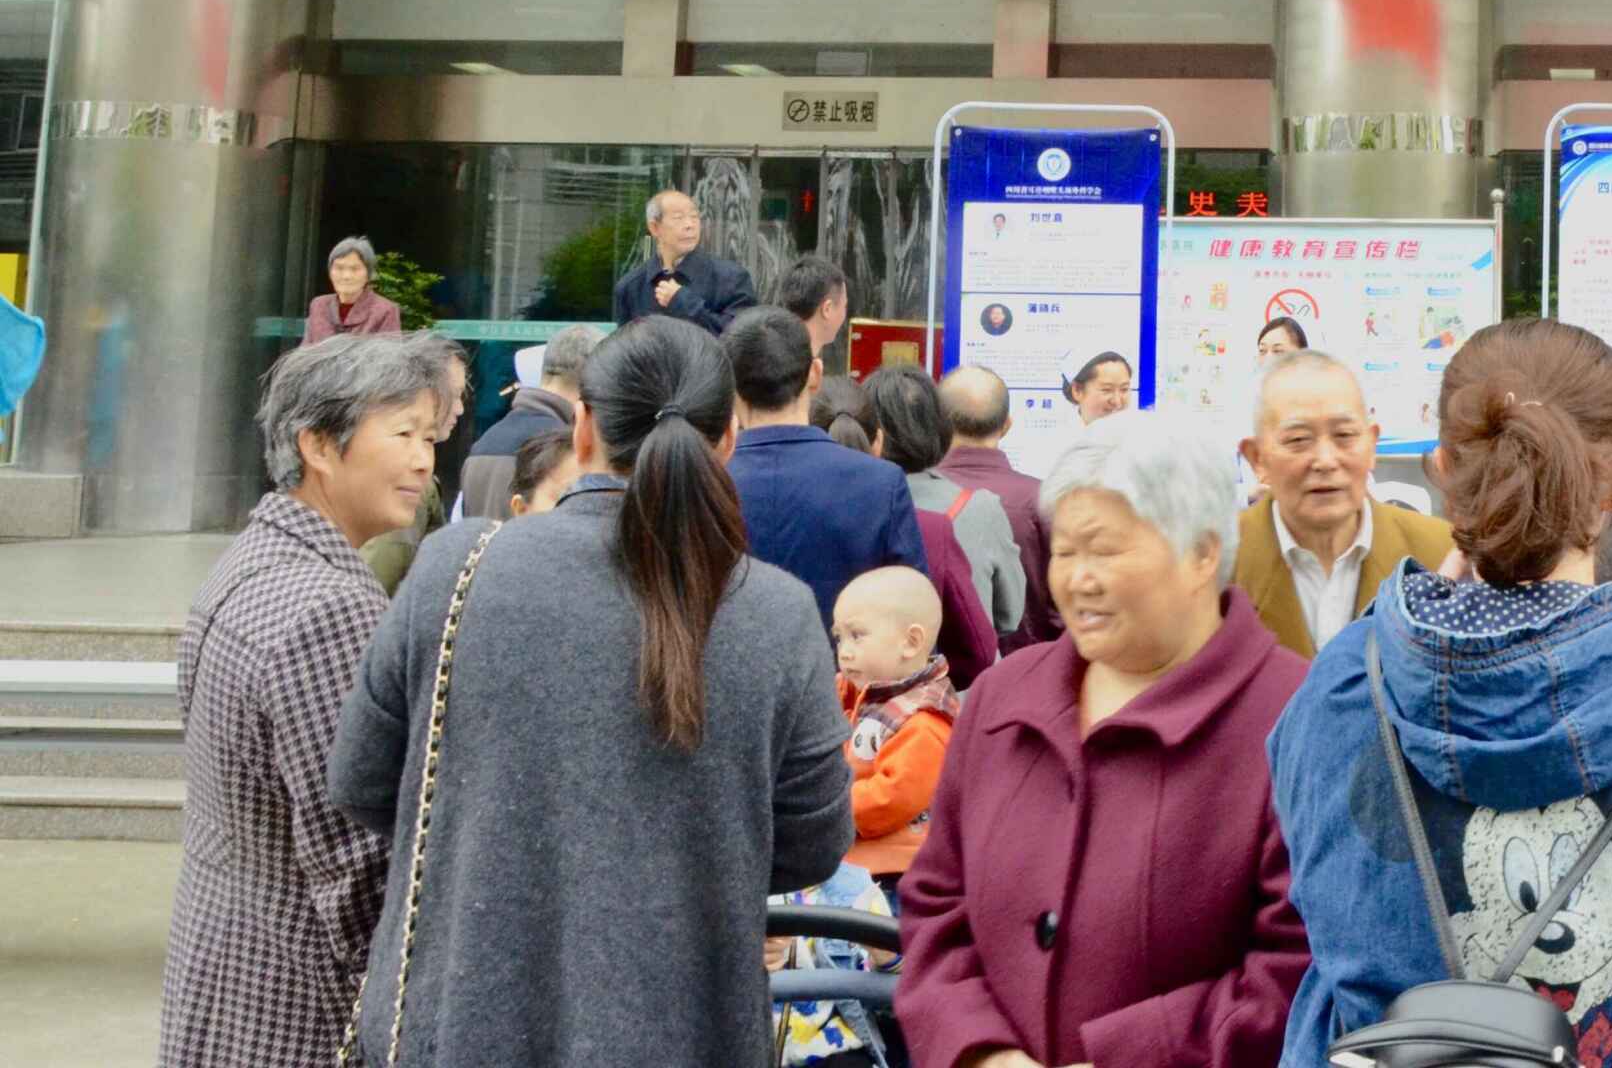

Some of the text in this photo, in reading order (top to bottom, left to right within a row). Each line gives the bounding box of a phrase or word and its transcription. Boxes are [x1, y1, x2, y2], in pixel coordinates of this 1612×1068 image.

[813, 100, 874, 122] 禁止吸烟
[1209, 237, 1422, 260] 健康教育宣传栏
